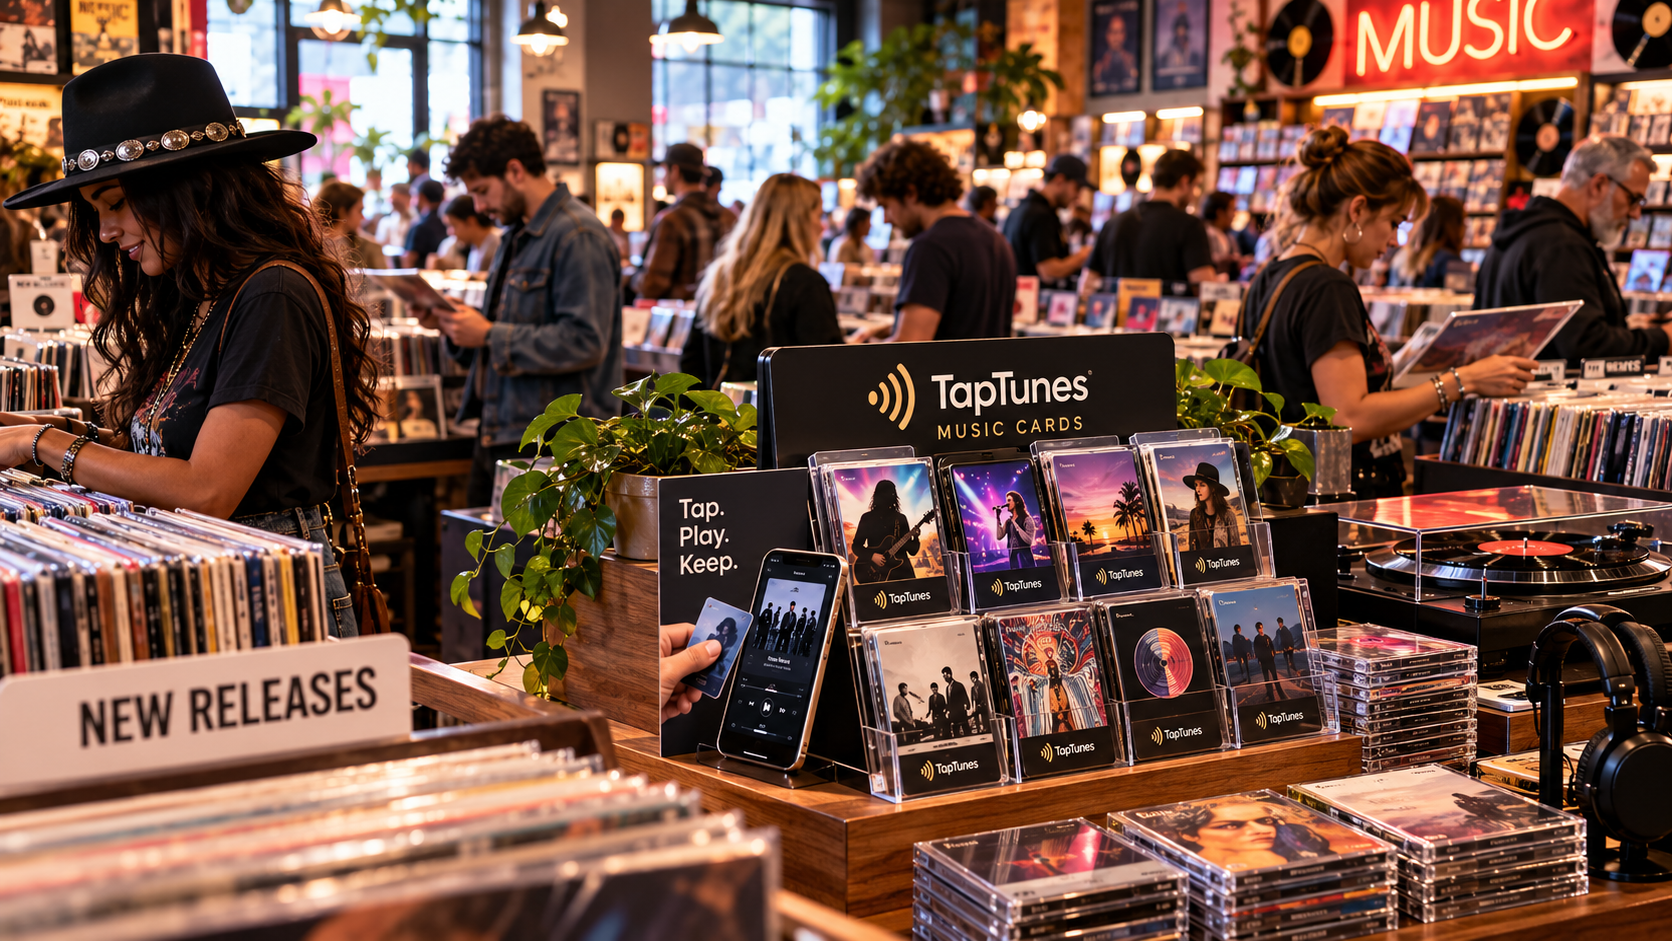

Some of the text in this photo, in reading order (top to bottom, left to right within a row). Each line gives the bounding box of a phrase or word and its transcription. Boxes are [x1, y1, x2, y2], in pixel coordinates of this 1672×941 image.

[1356, 0, 1573, 77] MUSIC
[931, 370, 1090, 416] TapTunes
[937, 416, 1084, 440] MUSIC CARDS
[678, 498, 725, 523] Tap.
[679, 525, 730, 549] Play.
[679, 554, 738, 576] Keep.
[79, 666, 378, 748] NEW RELEASES
